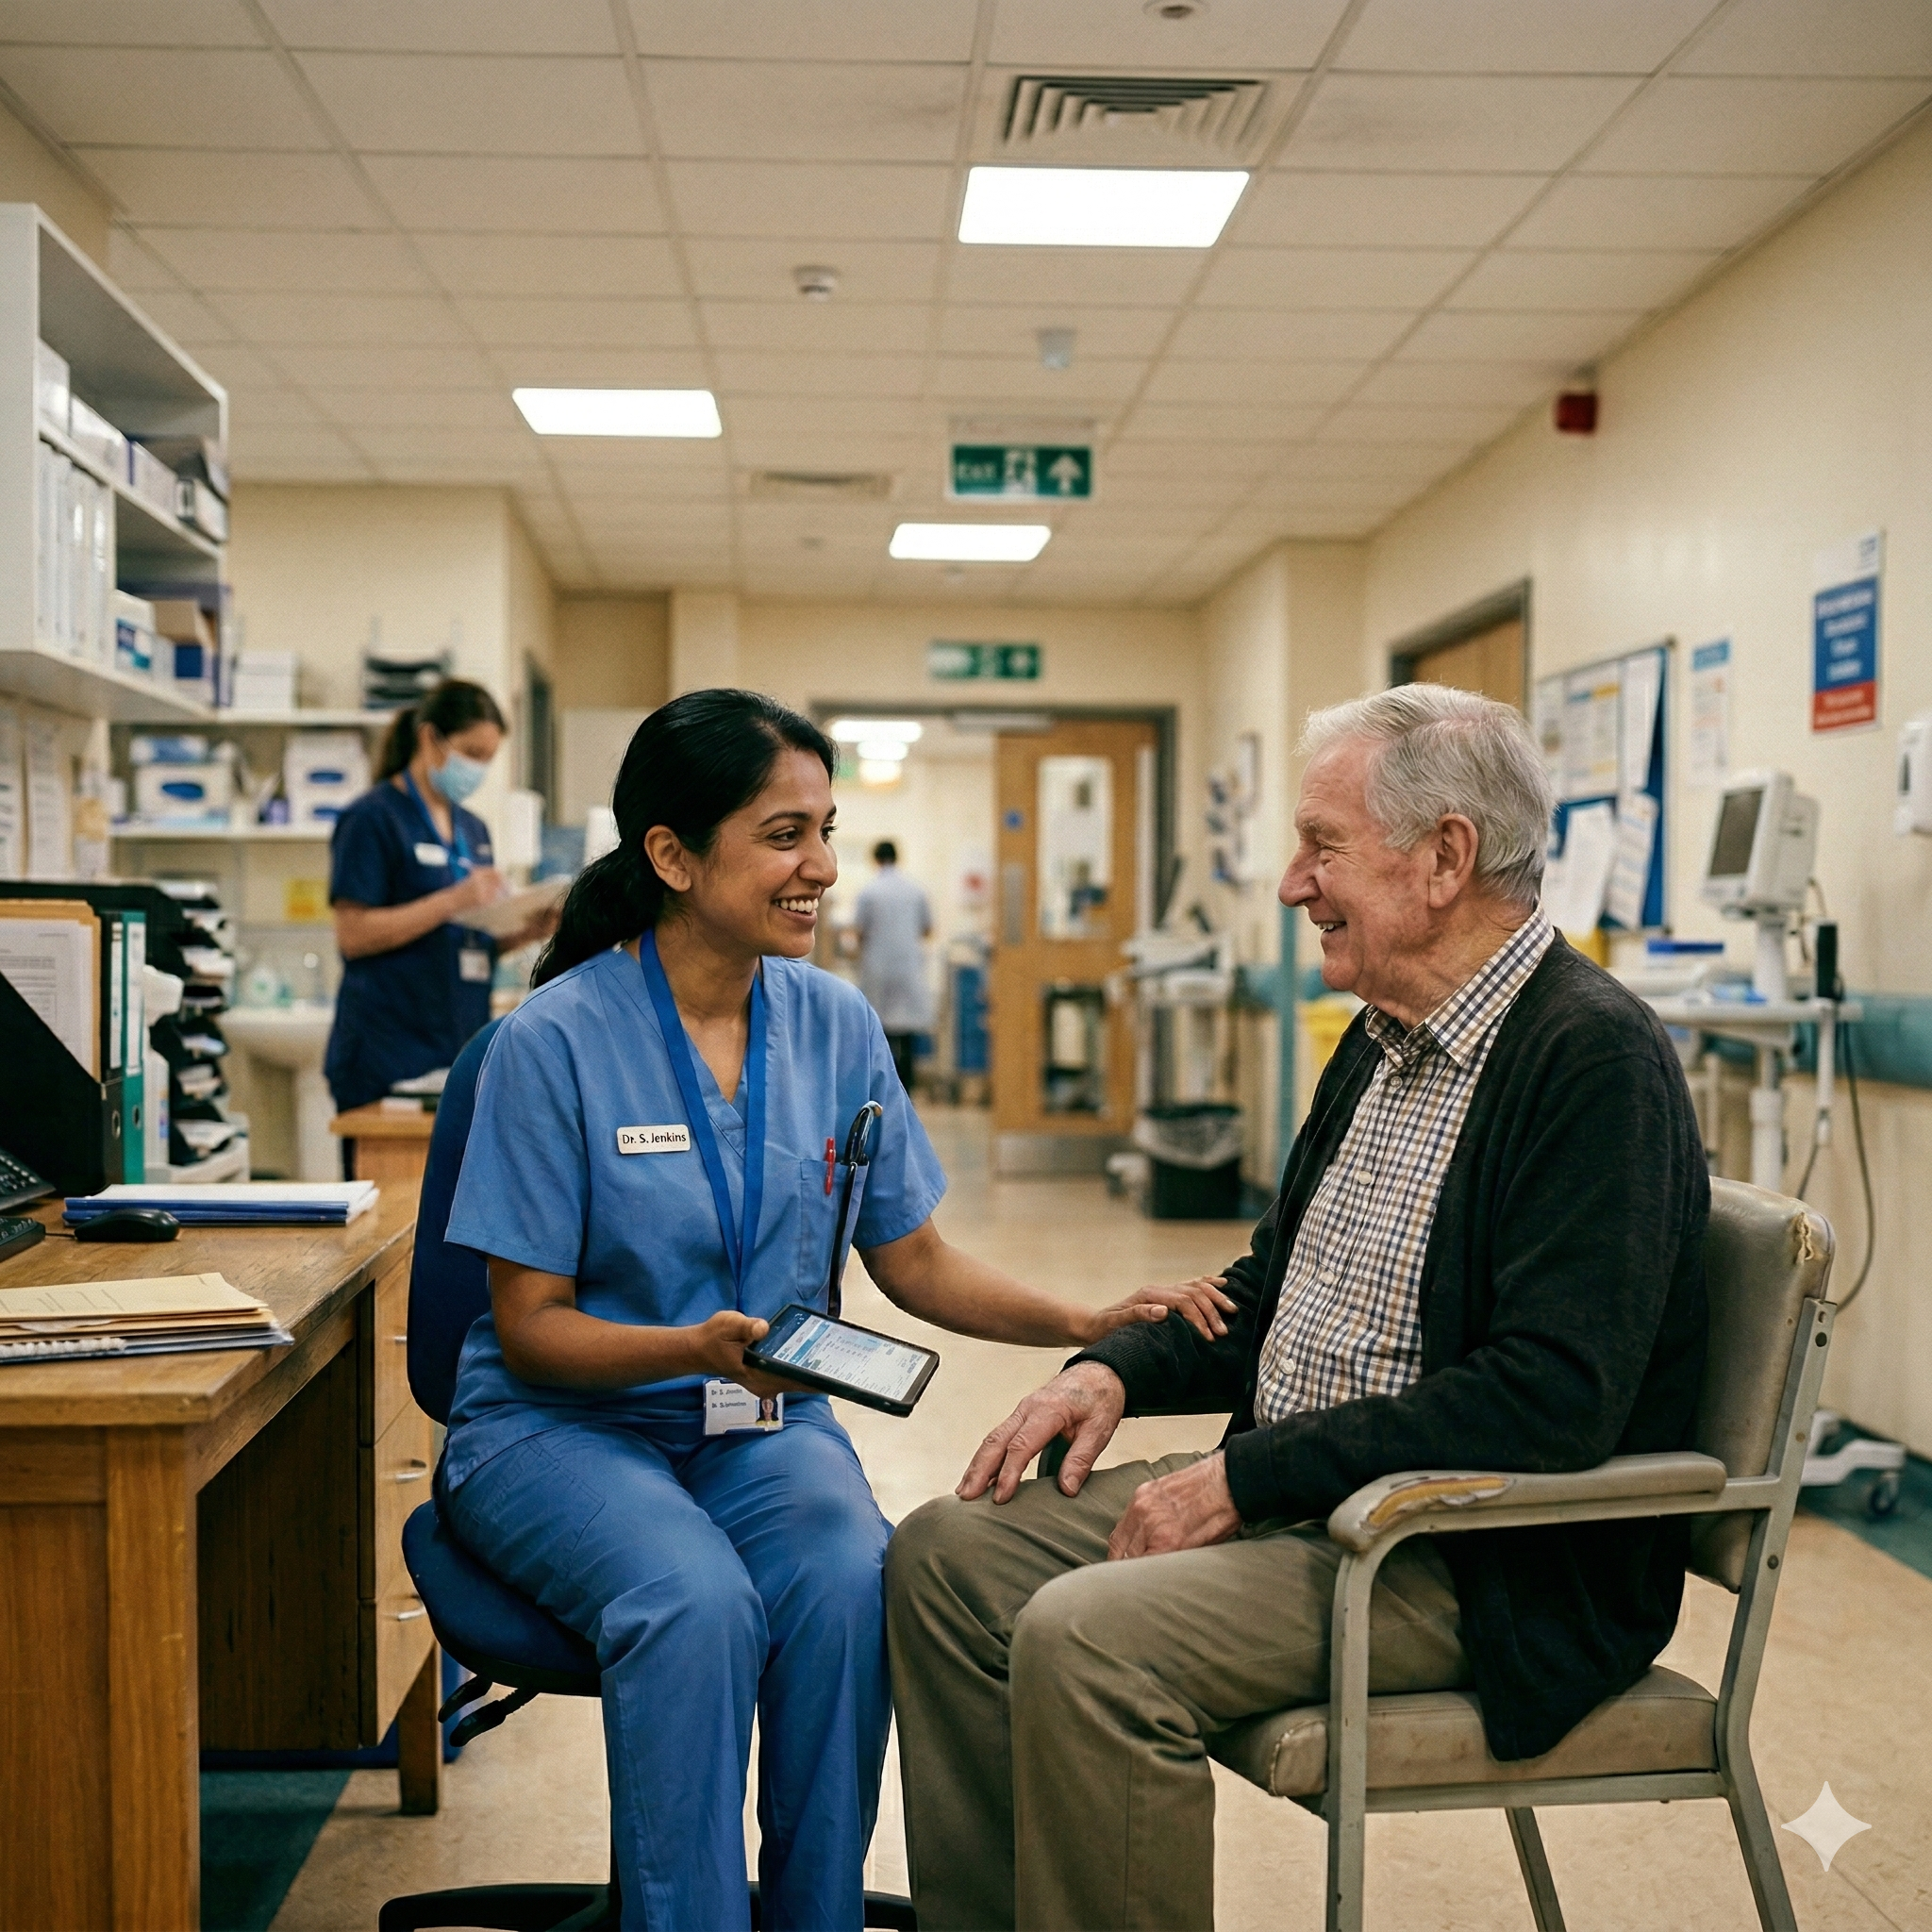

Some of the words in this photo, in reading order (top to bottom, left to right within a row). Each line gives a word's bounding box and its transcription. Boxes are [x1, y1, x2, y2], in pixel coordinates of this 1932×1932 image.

[622, 1134, 637, 1144] Dr.
[639, 1133, 649, 1143] S.
[651, 1132, 687, 1143] Jenkins
